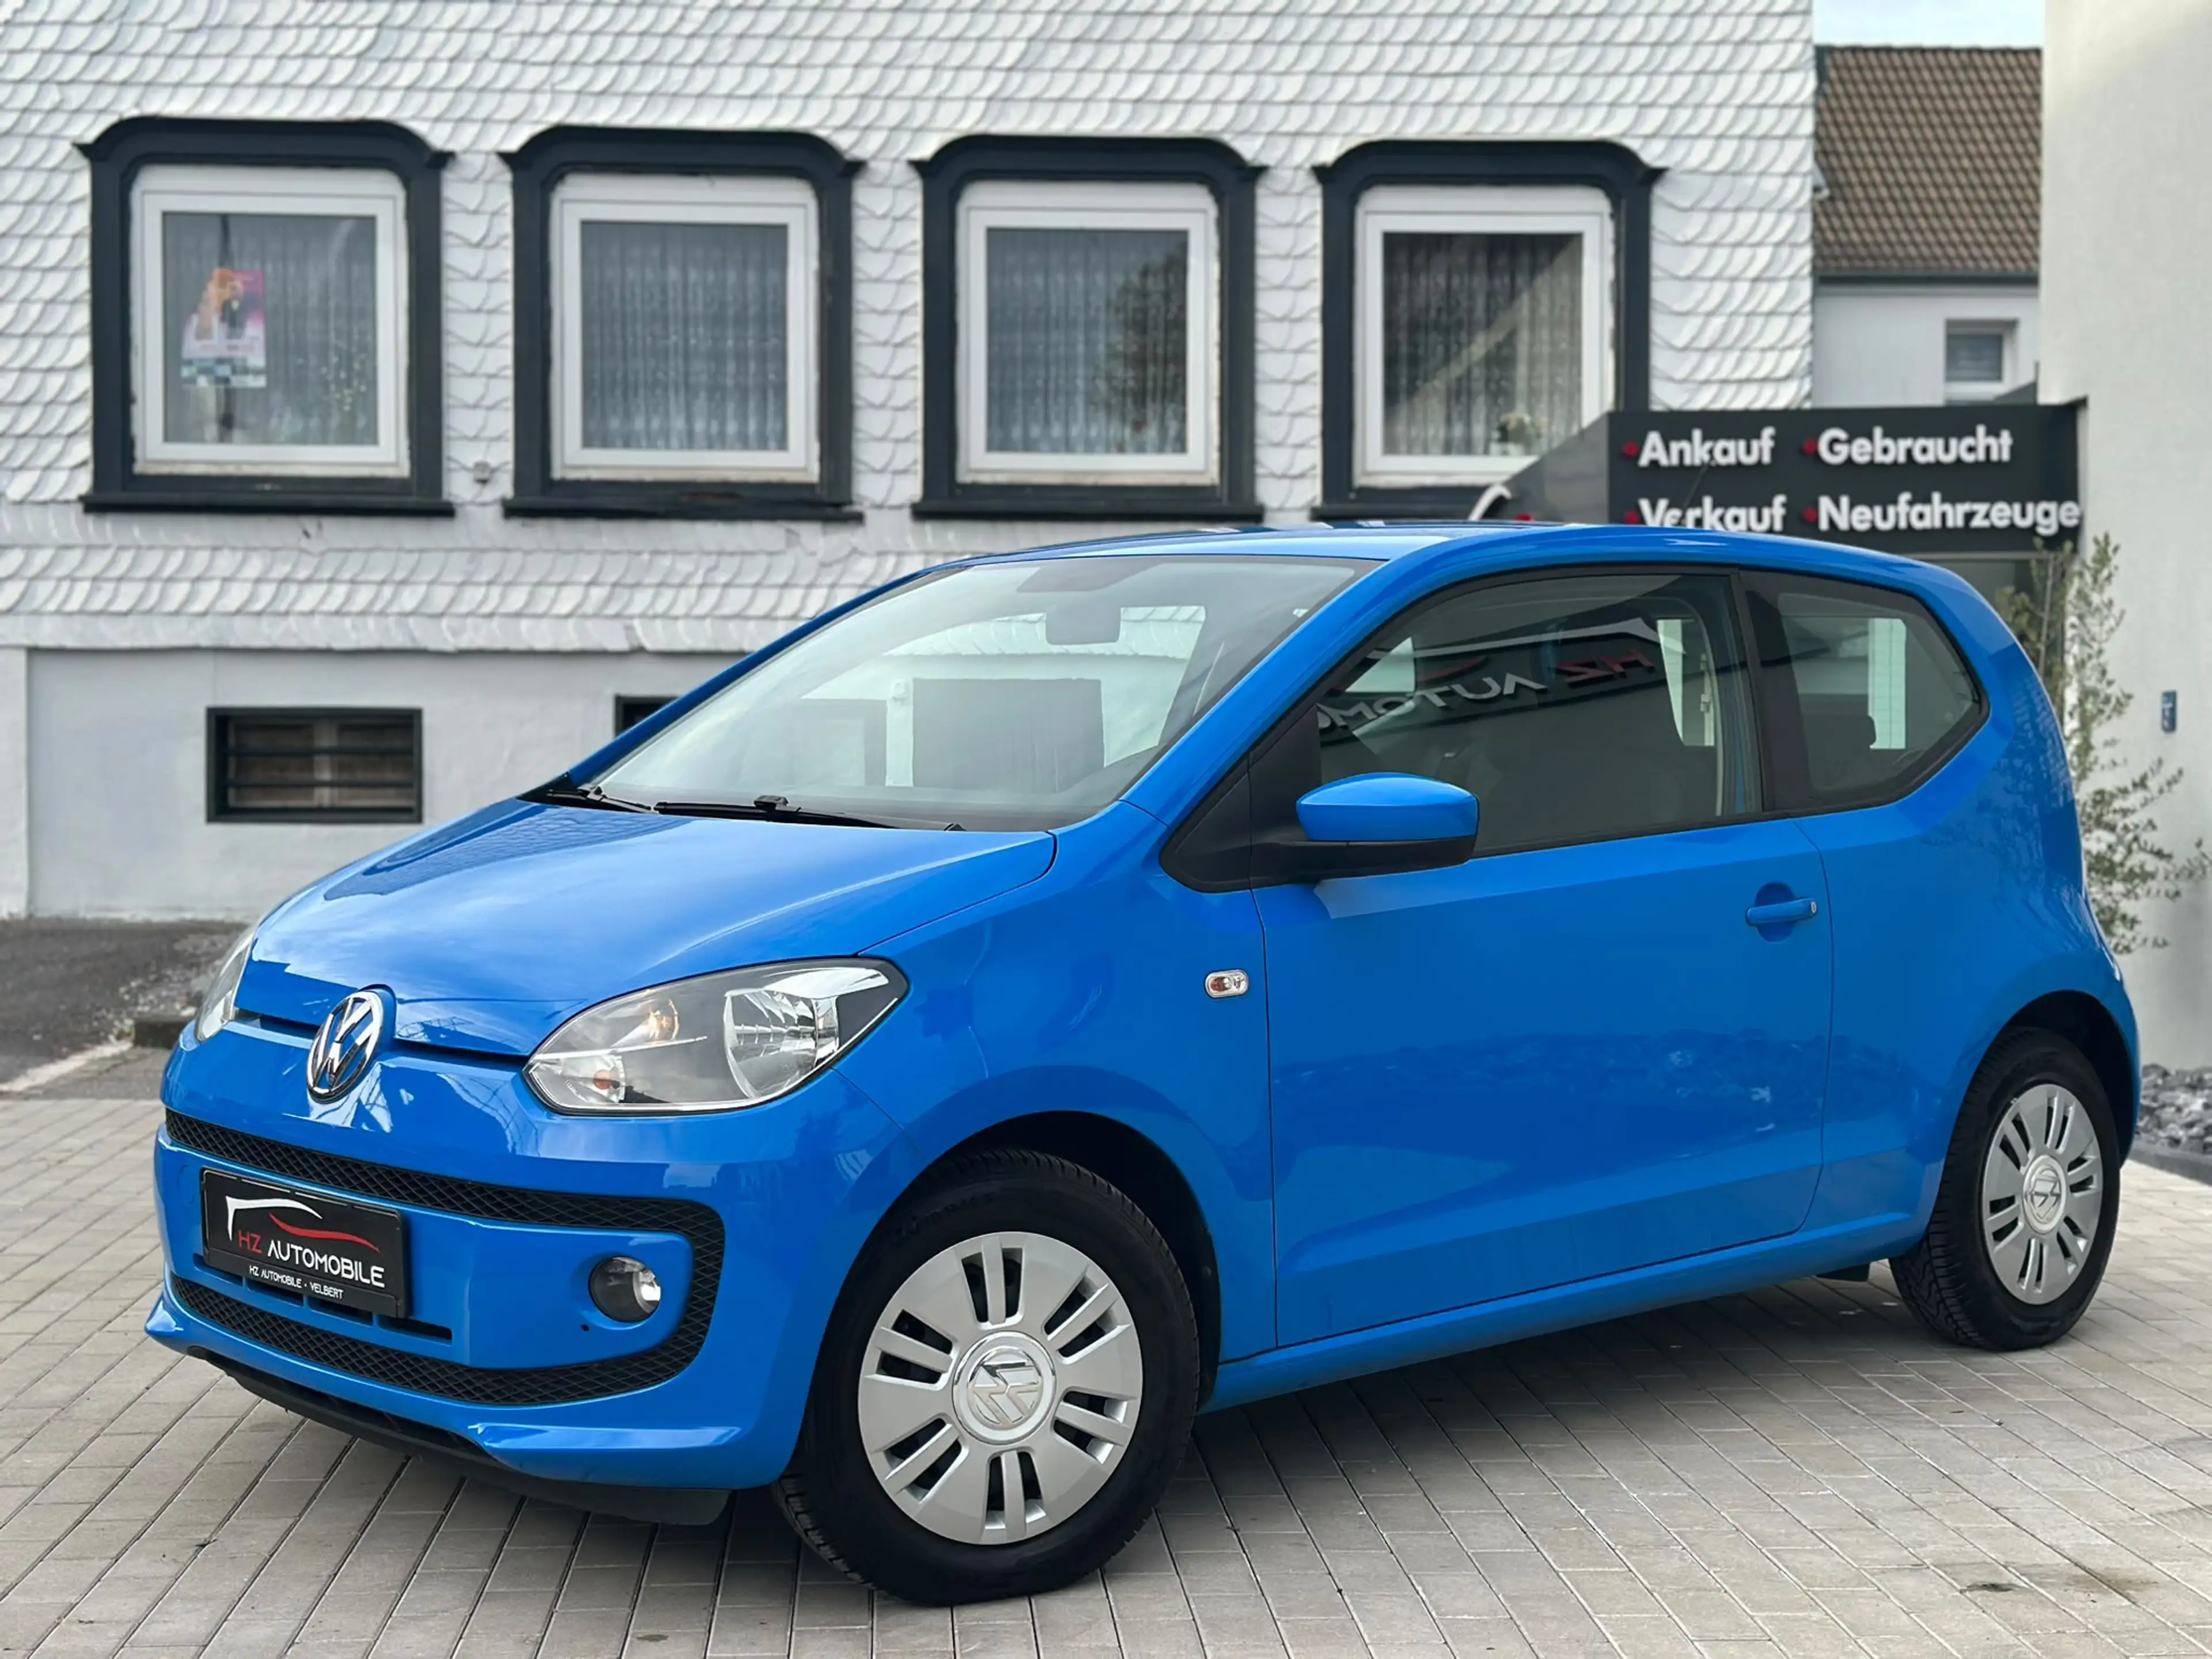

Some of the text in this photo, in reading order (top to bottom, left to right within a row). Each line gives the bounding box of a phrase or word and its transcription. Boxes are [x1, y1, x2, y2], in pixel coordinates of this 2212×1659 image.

[1637, 426, 1777, 467] Ankauf
[1817, 423, 2013, 465] Gebraucht
[1638, 494, 1787, 532] Verkauf
[1817, 491, 2081, 536] Neufahrzeuge
[238, 1229, 385, 1288] HZ AUTOMOBILE
[249, 1265, 344, 1300] HZ AUTOMOBILE VELBERT
